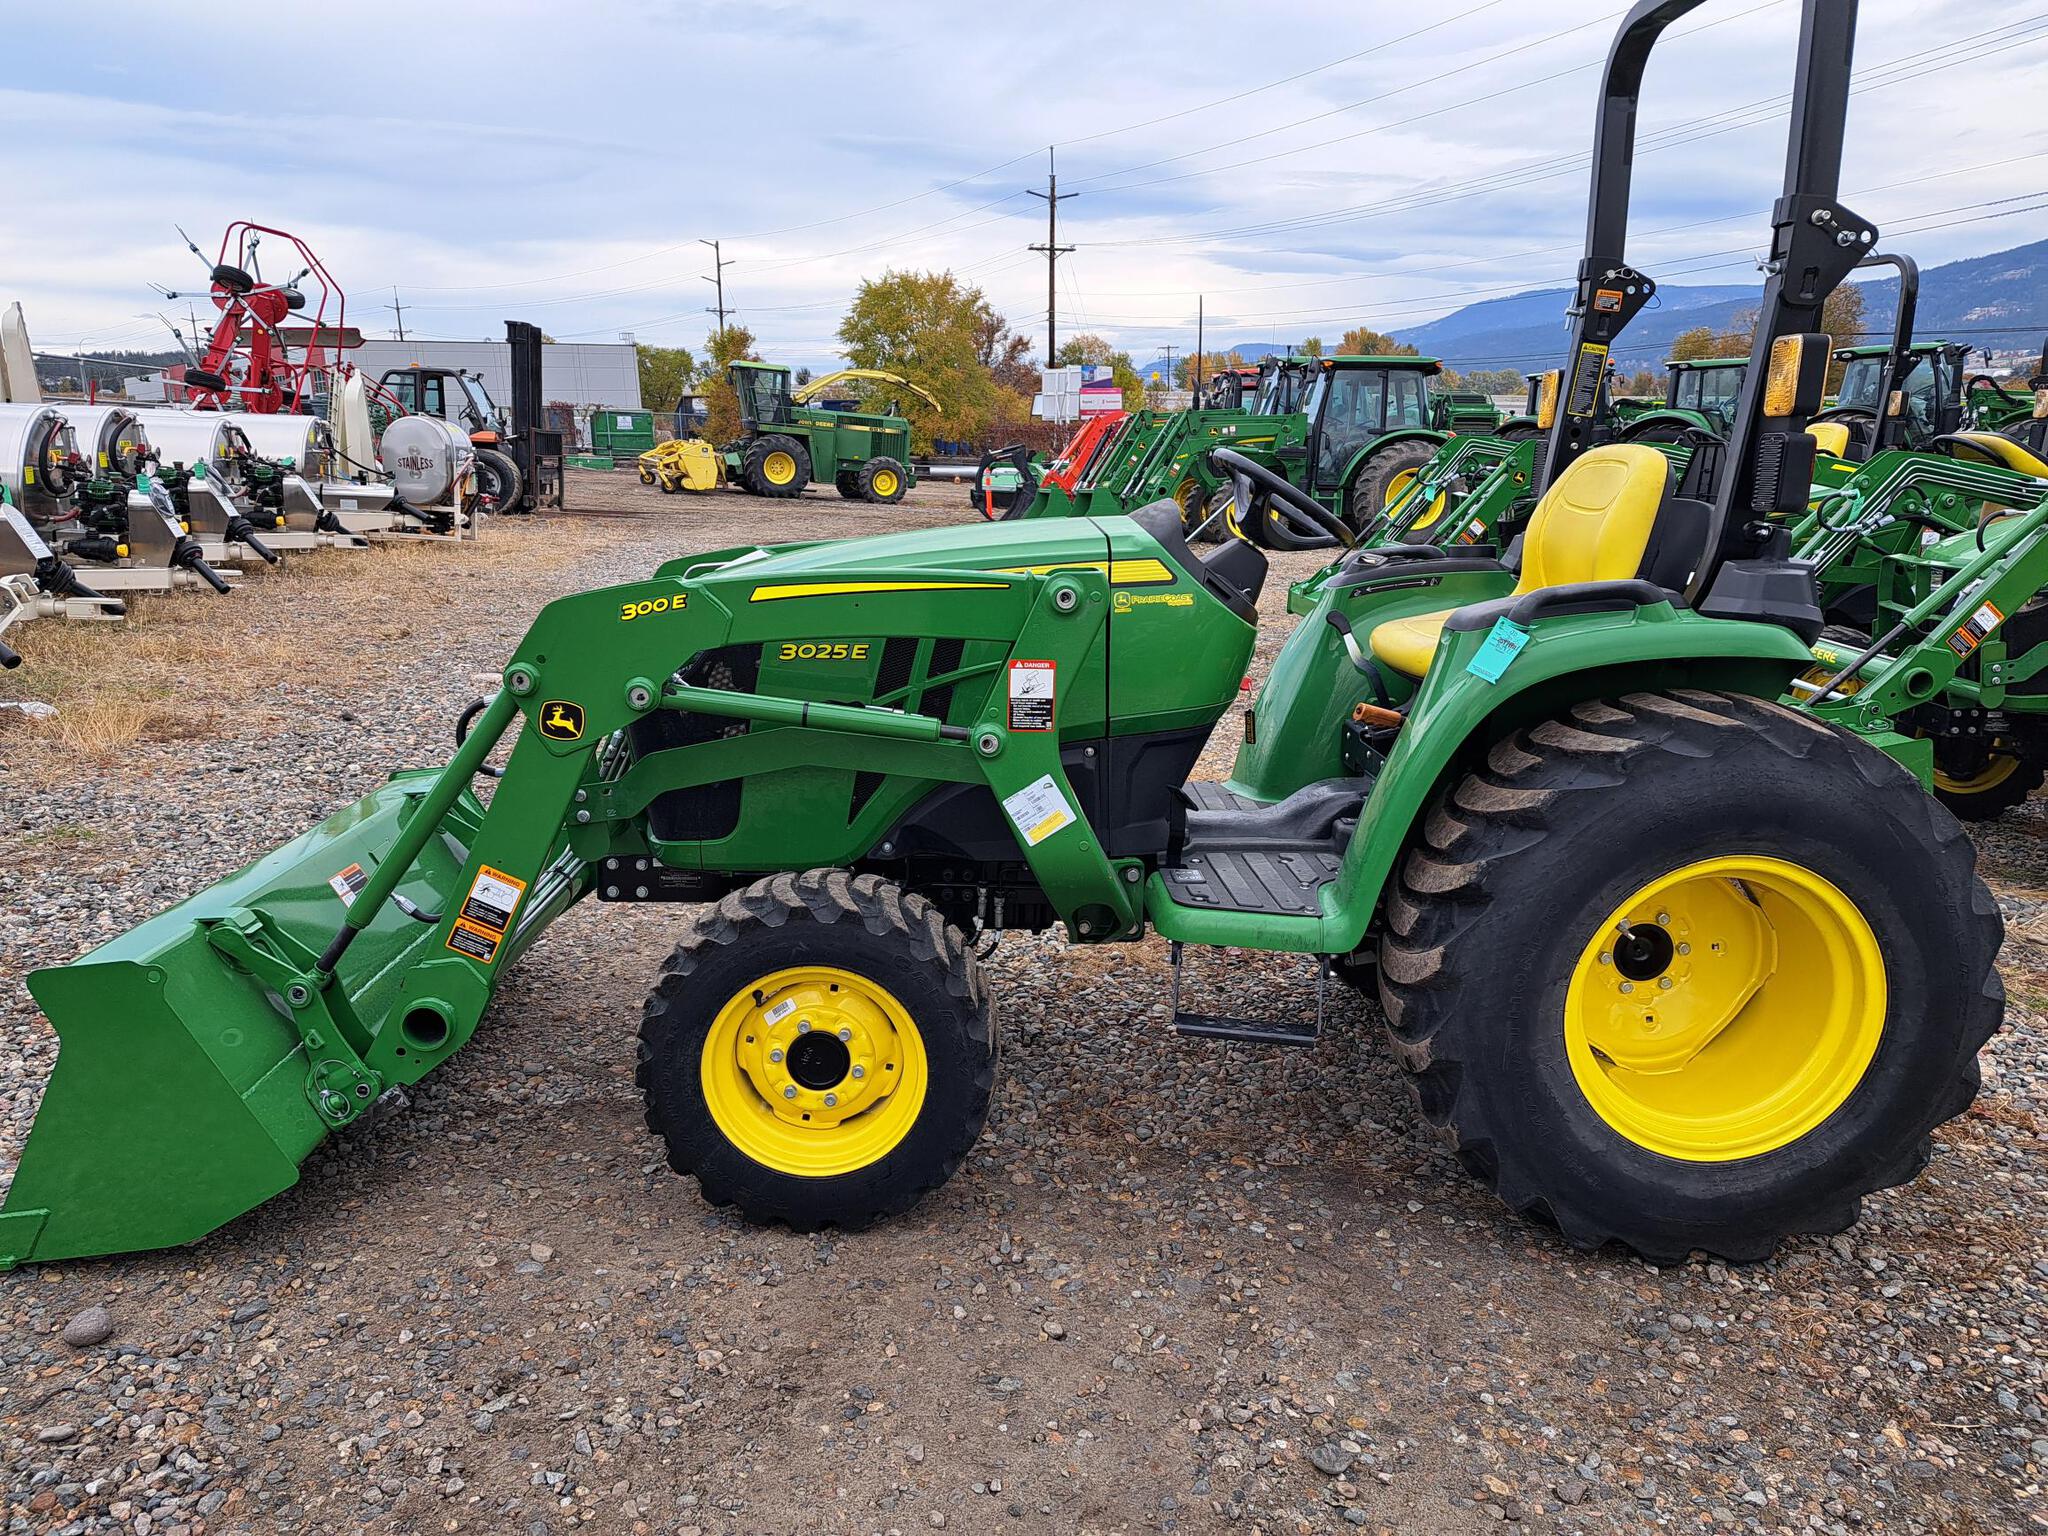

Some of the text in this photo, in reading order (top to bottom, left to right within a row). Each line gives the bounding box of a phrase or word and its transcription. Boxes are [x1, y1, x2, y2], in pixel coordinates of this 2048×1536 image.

[397, 455, 434, 472] STAINLESS
[779, 643, 870, 661] 3025E
[491, 870, 521, 888] WARNING
[467, 923, 497, 941] WARNING
